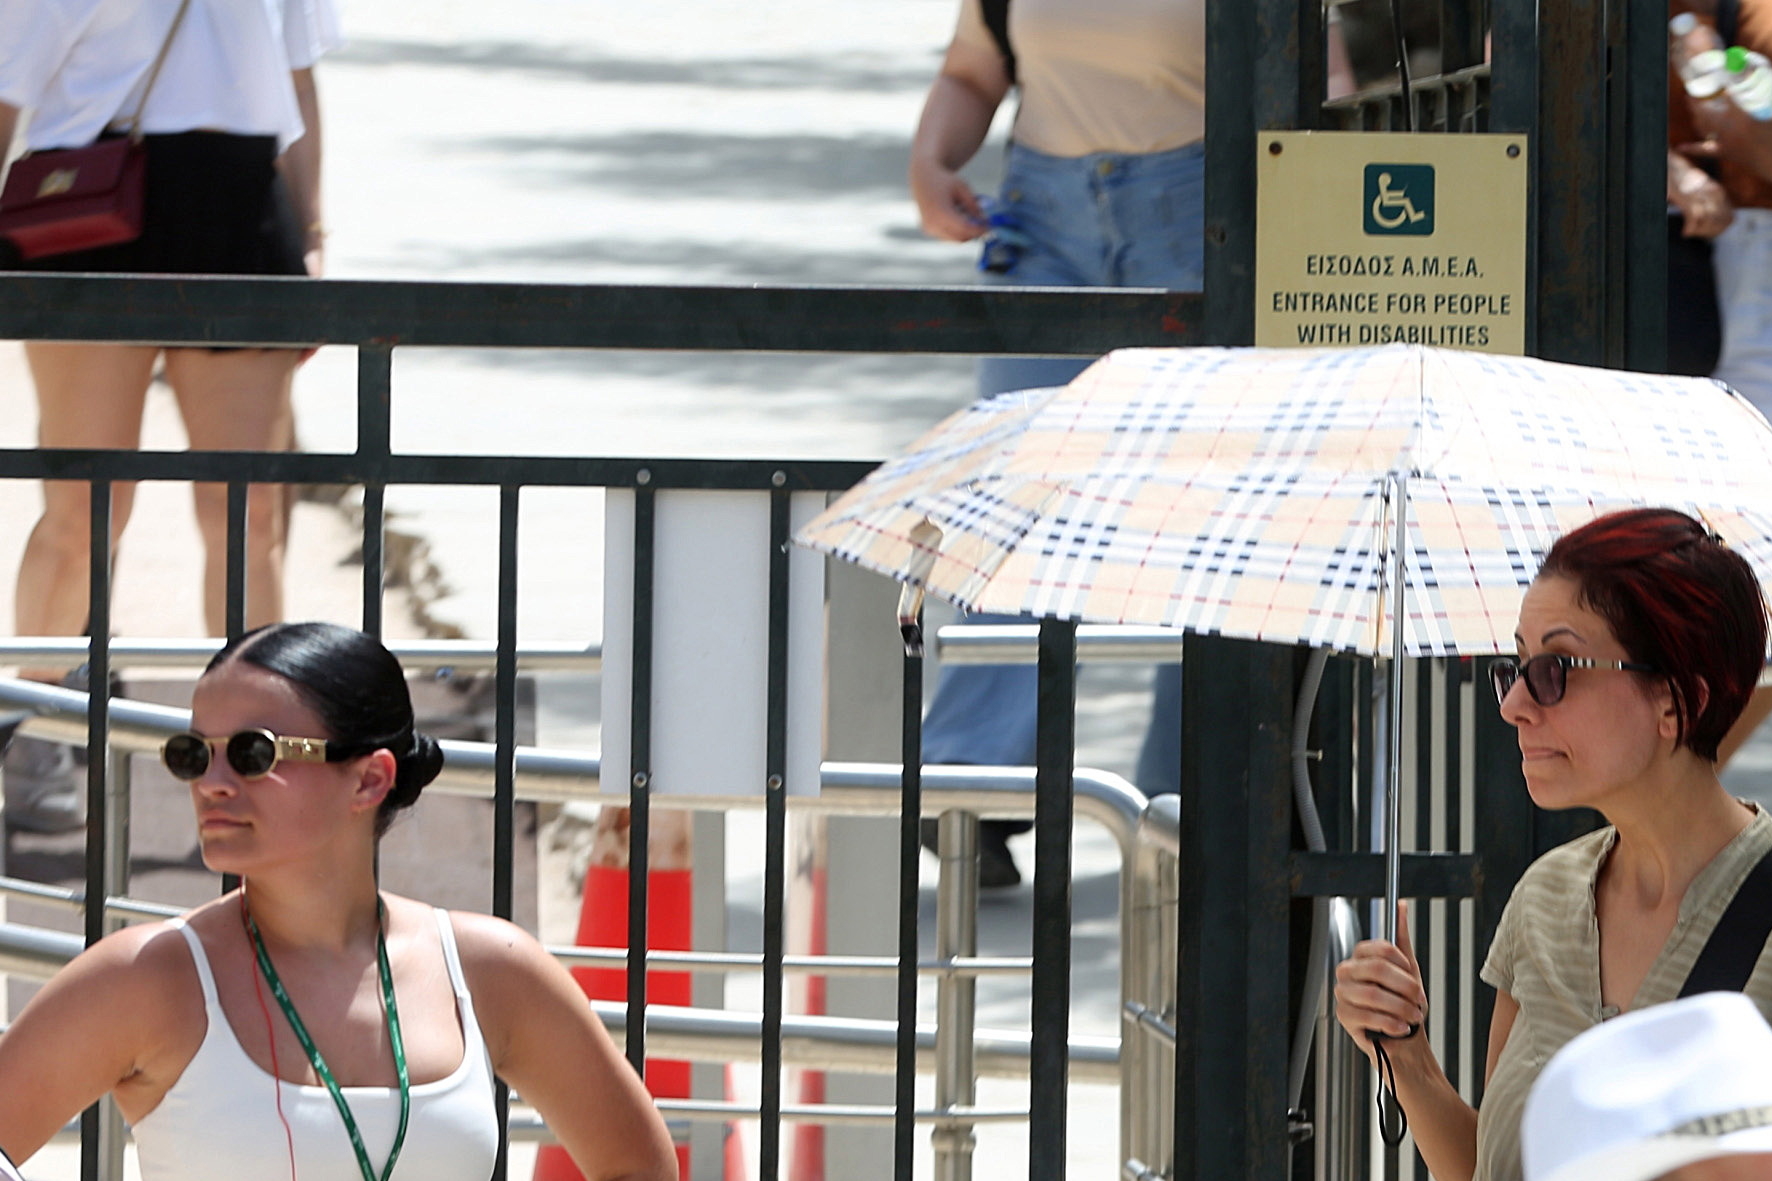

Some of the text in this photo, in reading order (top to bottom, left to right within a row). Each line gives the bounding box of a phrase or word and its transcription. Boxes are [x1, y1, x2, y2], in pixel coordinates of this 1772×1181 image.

[1306, 254, 1484, 278] ΕΙΣΟΔΟΣ Α.Μ.Ε.Α.
[1272, 291, 1511, 316] ENTRANCE FOR PEOPLE
[1297, 324, 1489, 346] WITH DISABILITIES
